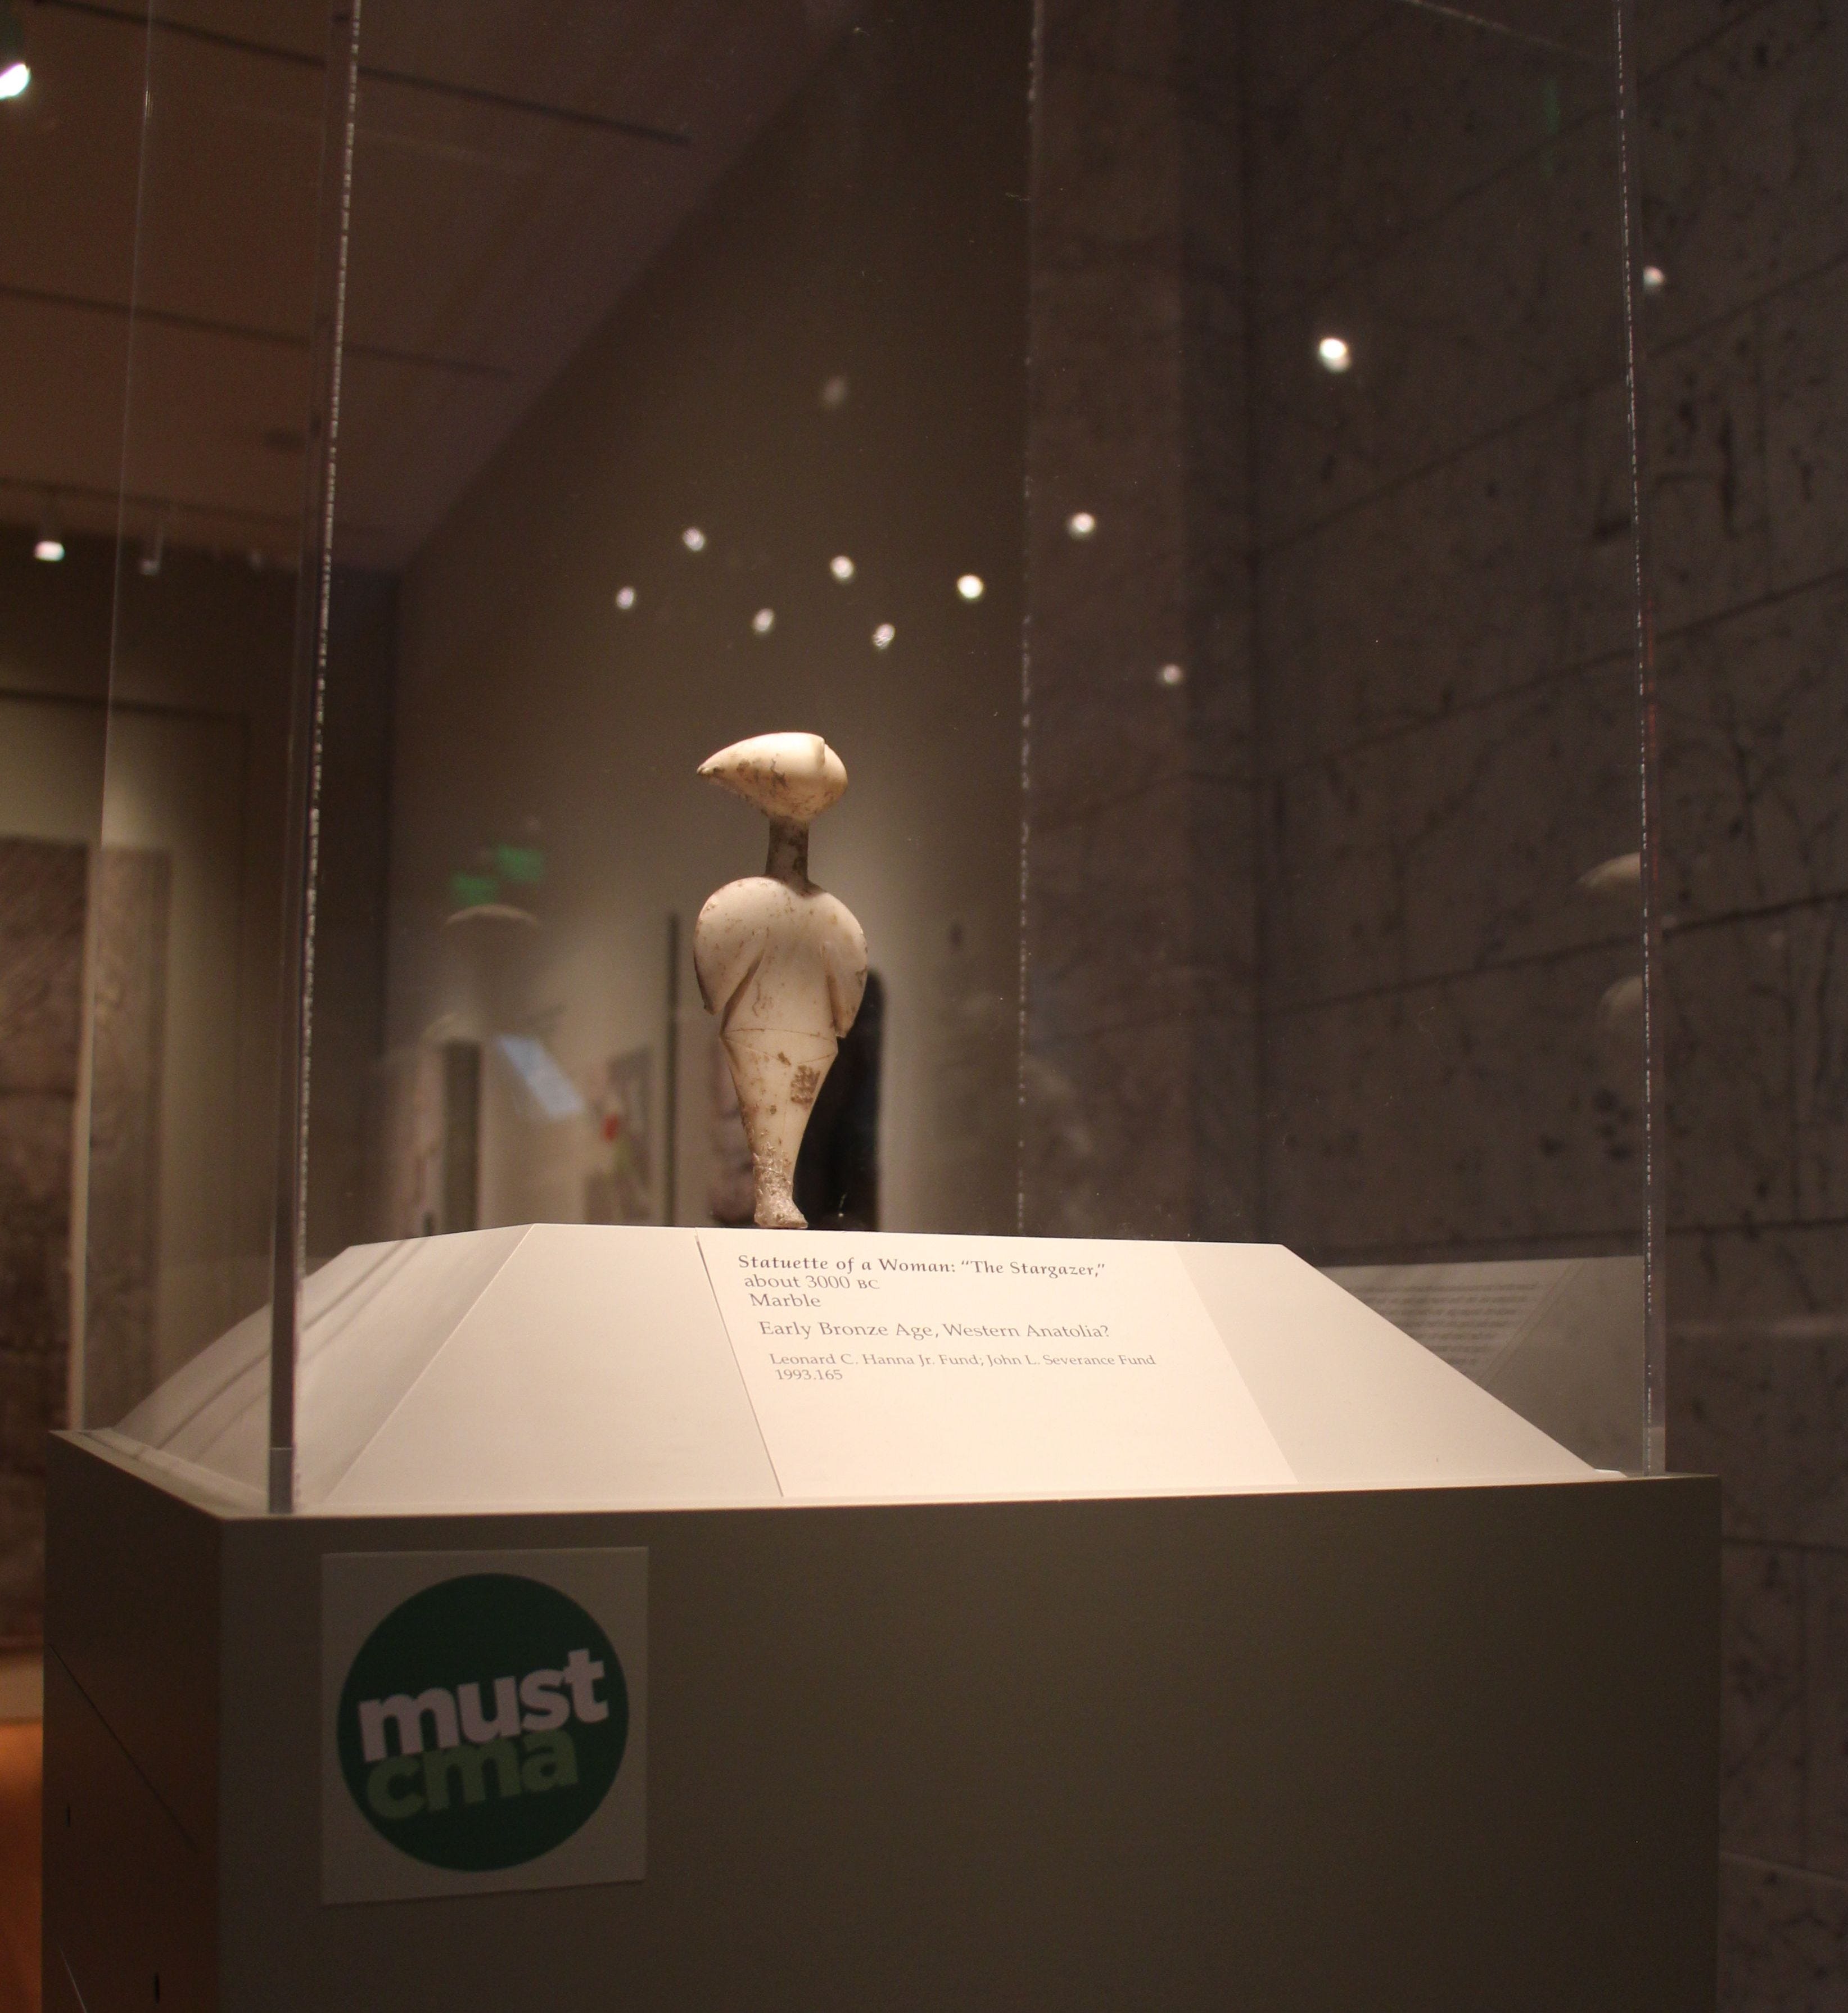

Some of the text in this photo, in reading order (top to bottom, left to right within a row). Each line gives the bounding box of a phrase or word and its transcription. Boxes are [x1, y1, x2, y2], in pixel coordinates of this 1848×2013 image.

[739, 1255, 828, 1269] Statuette
[837, 1257, 854, 1274] of
[862, 1261, 871, 1270] a
[878, 1259, 955, 1272] Woman:
[744, 1274, 879, 1289] about 3000 BC
[749, 1293, 821, 1307] Marble
[759, 1322, 1109, 1340] Early Bronze Age, Western Anatolia?
[770, 1354, 1156, 1367] Leonard C. Hanna Jr. Fund; John L. Severance Fund
[776, 1369, 842, 1379] 1993.165
[359, 1648, 609, 1763] must
[367, 1730, 579, 1819] cma
